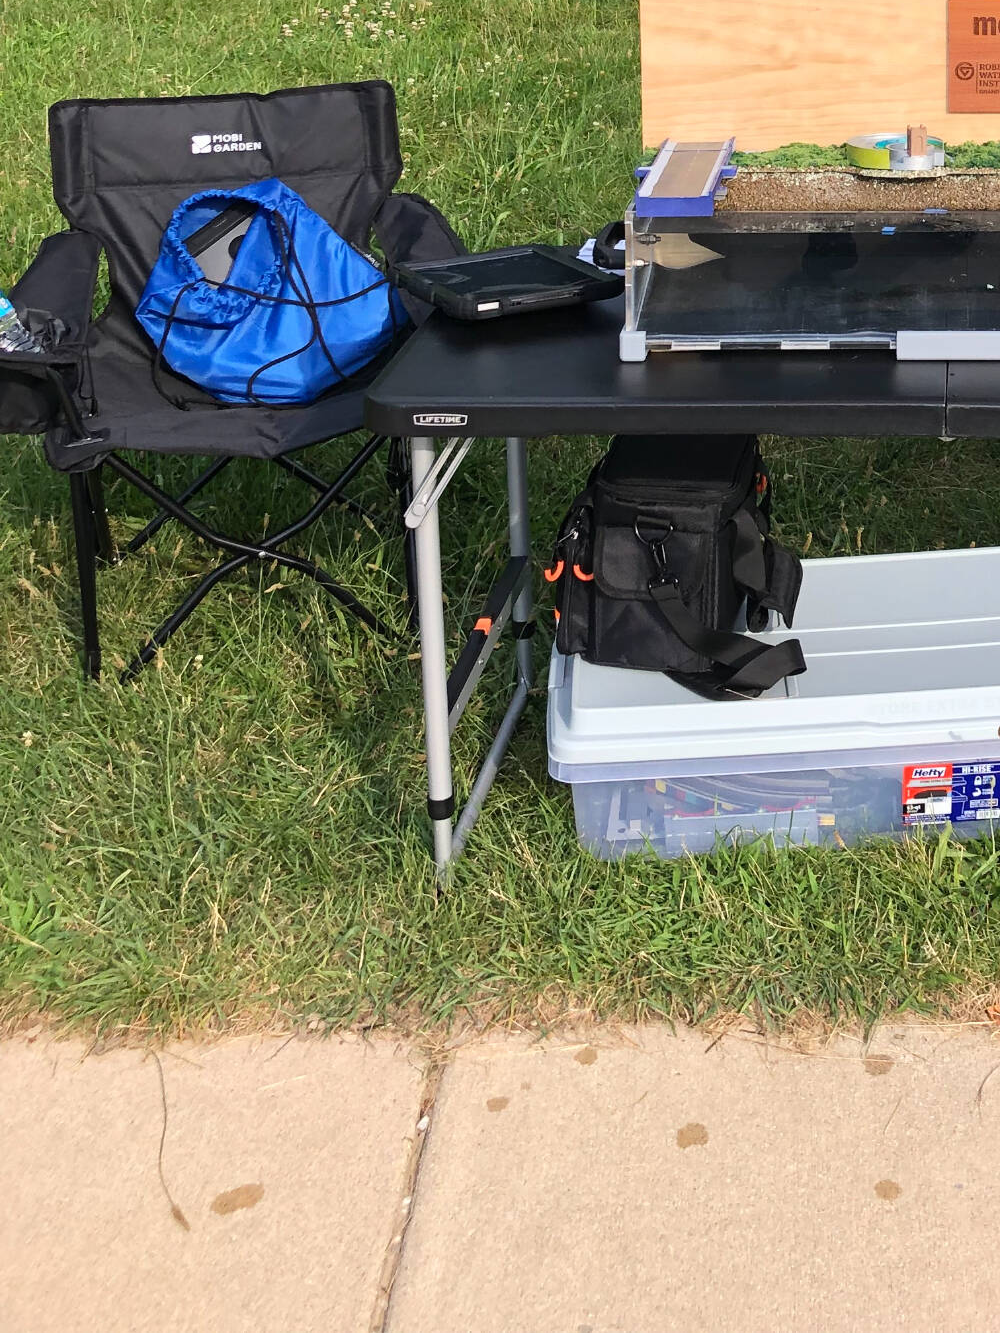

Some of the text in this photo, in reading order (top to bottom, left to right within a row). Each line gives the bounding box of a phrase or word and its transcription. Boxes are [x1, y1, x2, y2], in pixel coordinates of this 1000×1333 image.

[213, 134, 242, 142] MOBI
[213, 142, 262, 152] GARDEN
[914, 769, 944, 777] Hefty
